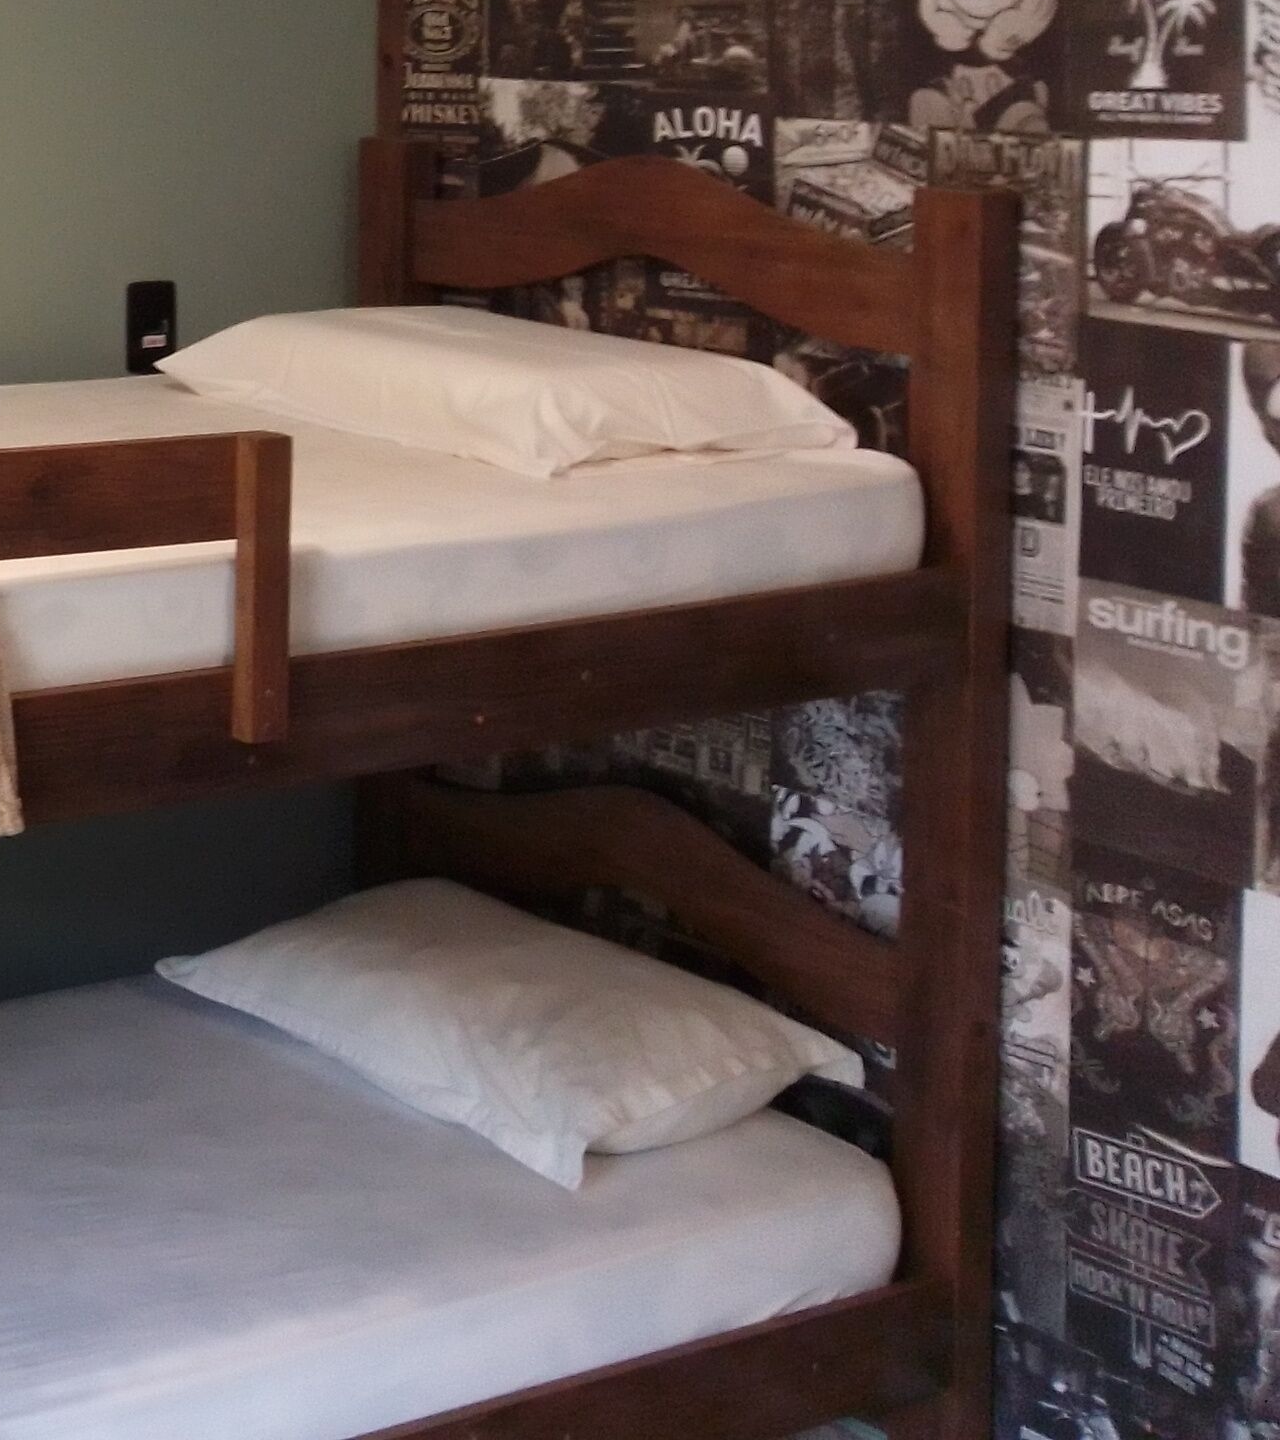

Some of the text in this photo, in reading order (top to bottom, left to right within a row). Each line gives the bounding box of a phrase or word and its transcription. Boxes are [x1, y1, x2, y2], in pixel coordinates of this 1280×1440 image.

[653, 105, 765, 148] ALOHA
[1088, 597, 1250, 670] surfing
[1085, 1138, 1188, 1205] BEACH
[1089, 1200, 1184, 1277] SKATE
